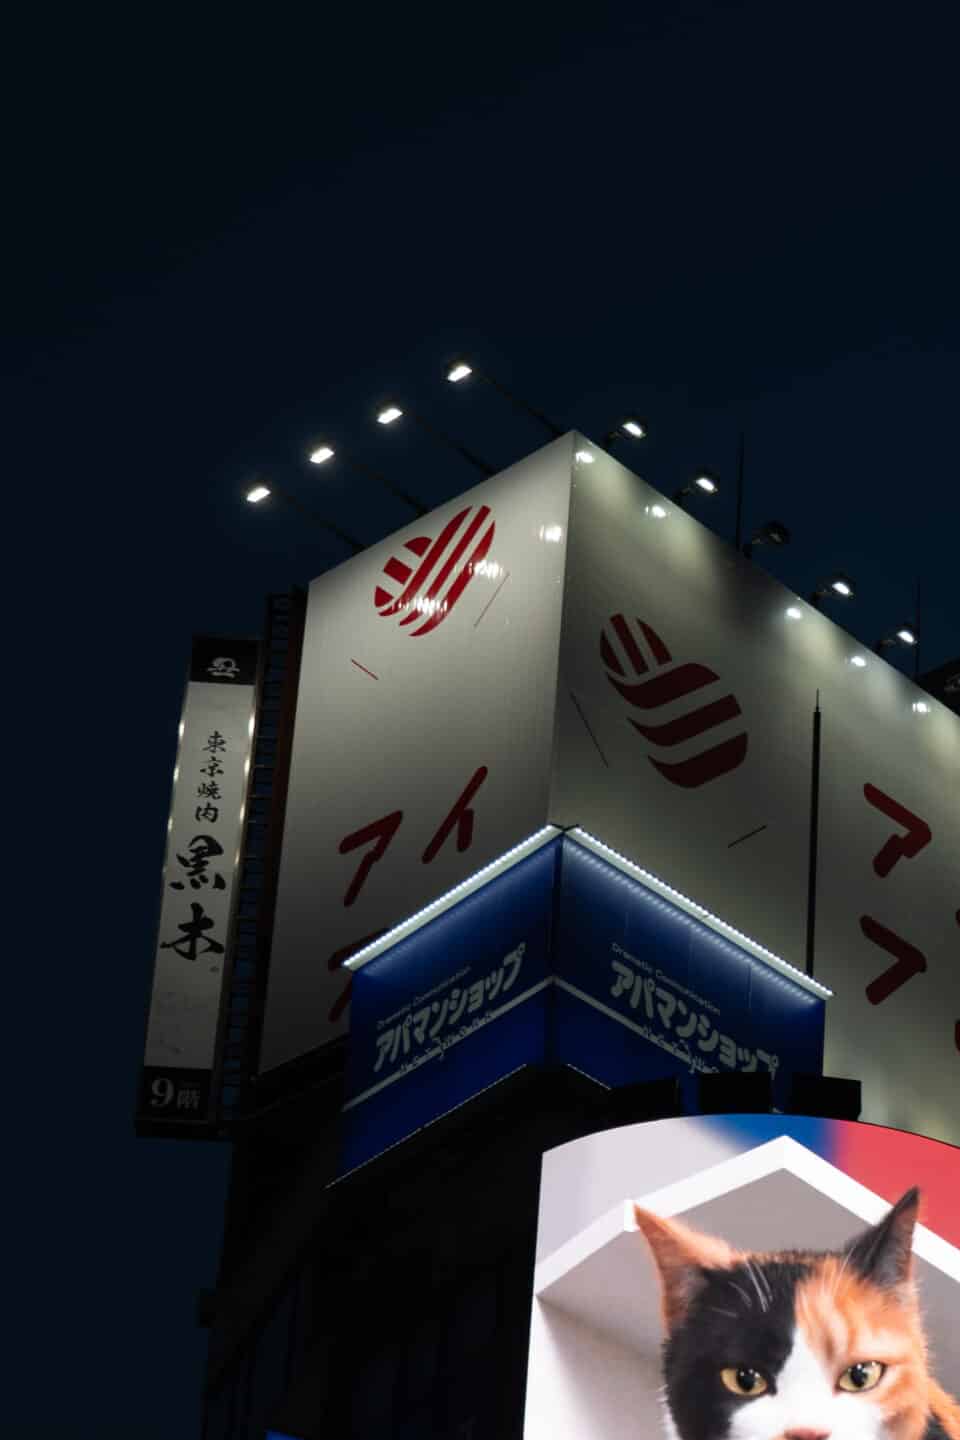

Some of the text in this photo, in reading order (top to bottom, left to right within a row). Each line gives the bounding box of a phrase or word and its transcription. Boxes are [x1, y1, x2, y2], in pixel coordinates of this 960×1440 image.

[160, 833, 226, 962] 黒木
[373, 940, 528, 1074] アパマンショップ
